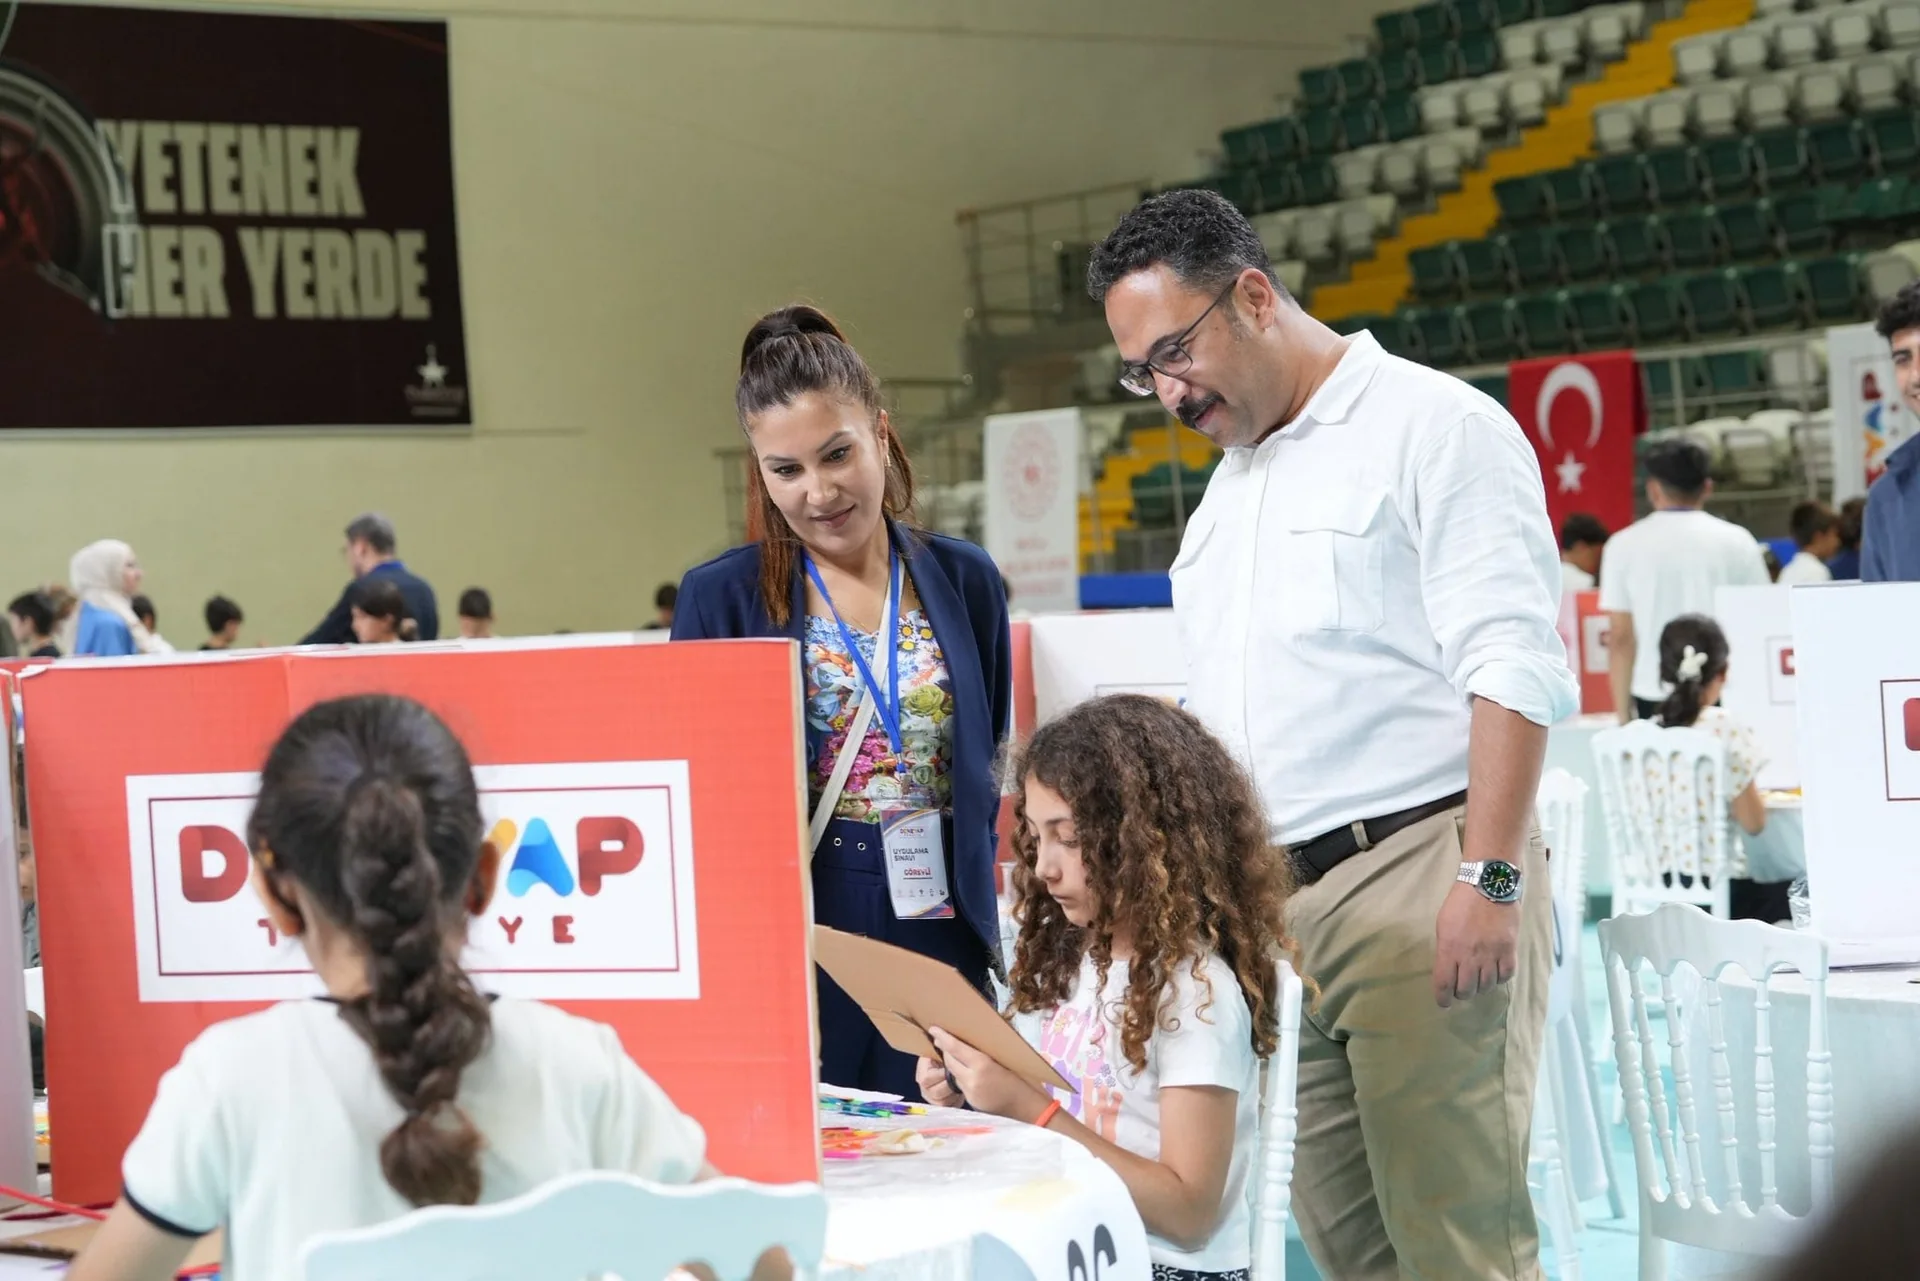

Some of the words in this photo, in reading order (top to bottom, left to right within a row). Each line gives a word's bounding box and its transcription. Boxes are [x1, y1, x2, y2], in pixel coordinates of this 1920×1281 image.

[95, 119, 365, 217] YETENEK
[103, 223, 230, 319] HER
[237, 227, 432, 319] YERDE
[892, 847, 929, 855] UYGULAMA
